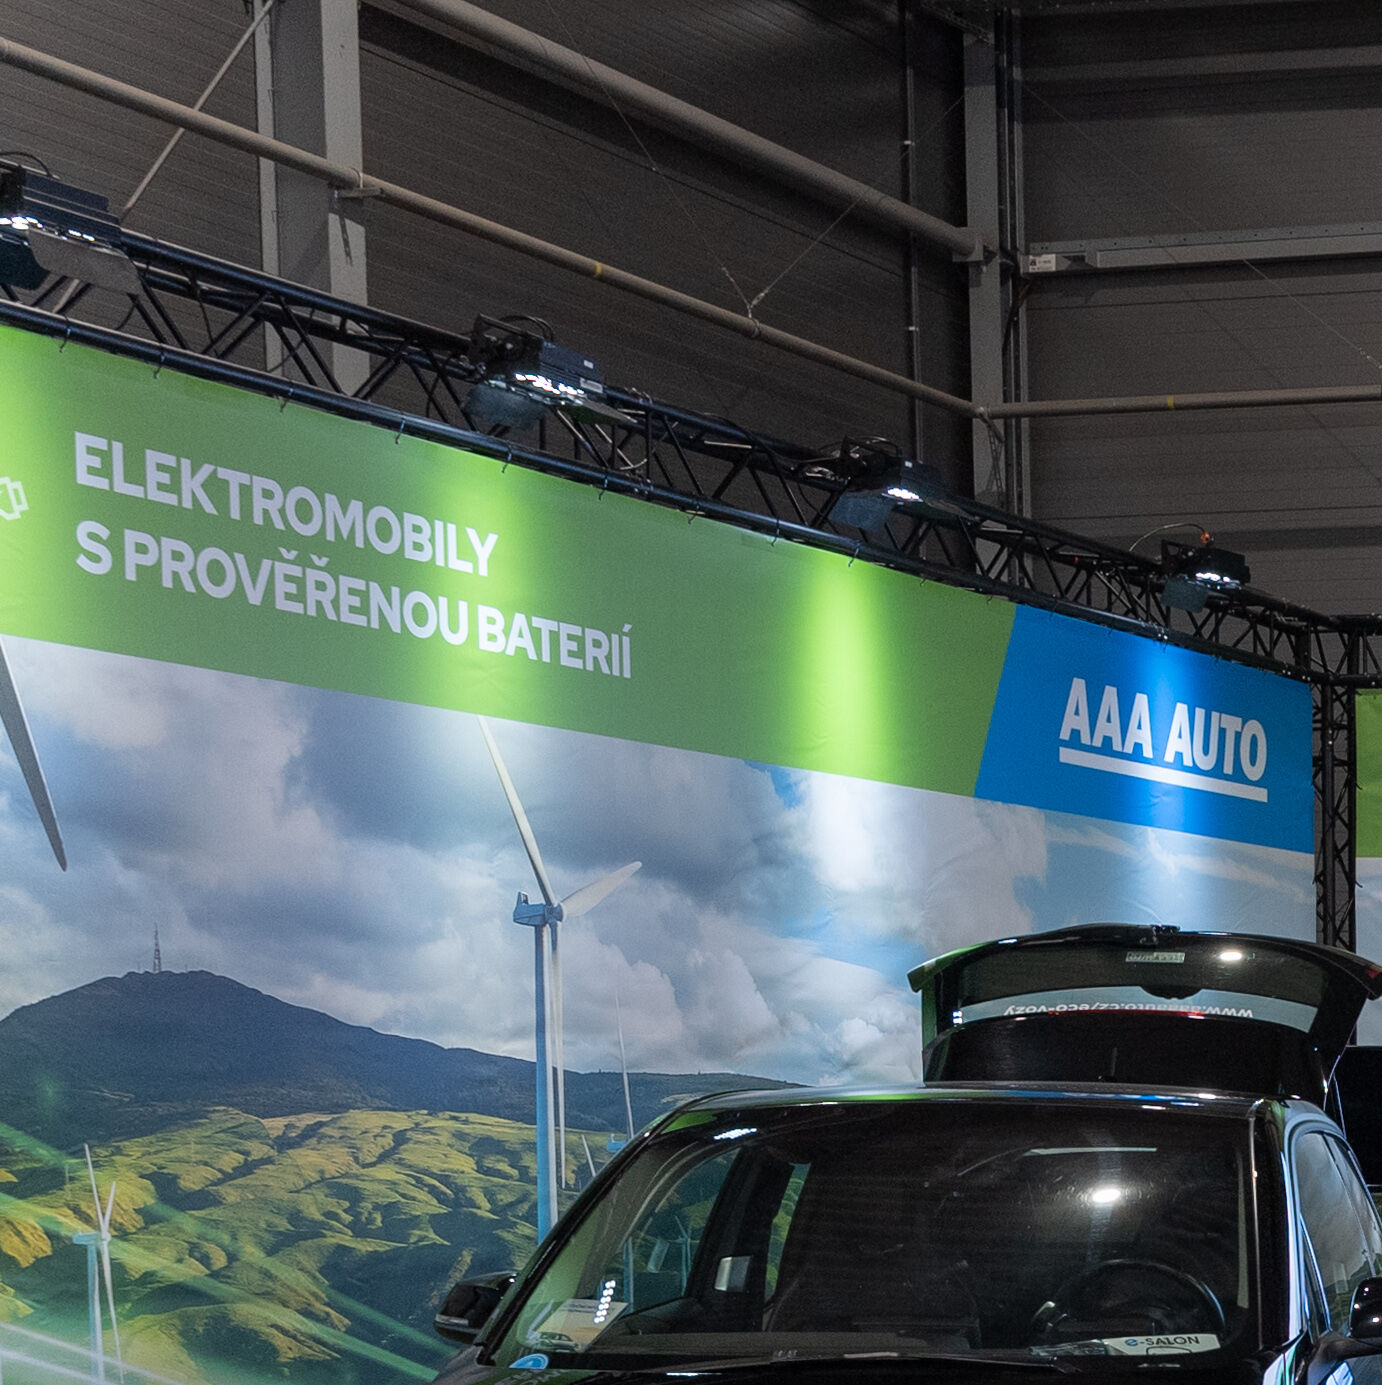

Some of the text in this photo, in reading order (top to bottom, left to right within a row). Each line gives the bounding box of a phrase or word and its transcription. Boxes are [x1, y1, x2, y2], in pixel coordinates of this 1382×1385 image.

[74, 431, 498, 576] ELEKTROMOBILY
[75, 521, 632, 678] S PROVĚŘENOU BATERIÍ
[1060, 677, 1267, 781] AAA AUTO
[1125, 1336, 1200, 1347] e-SALON
